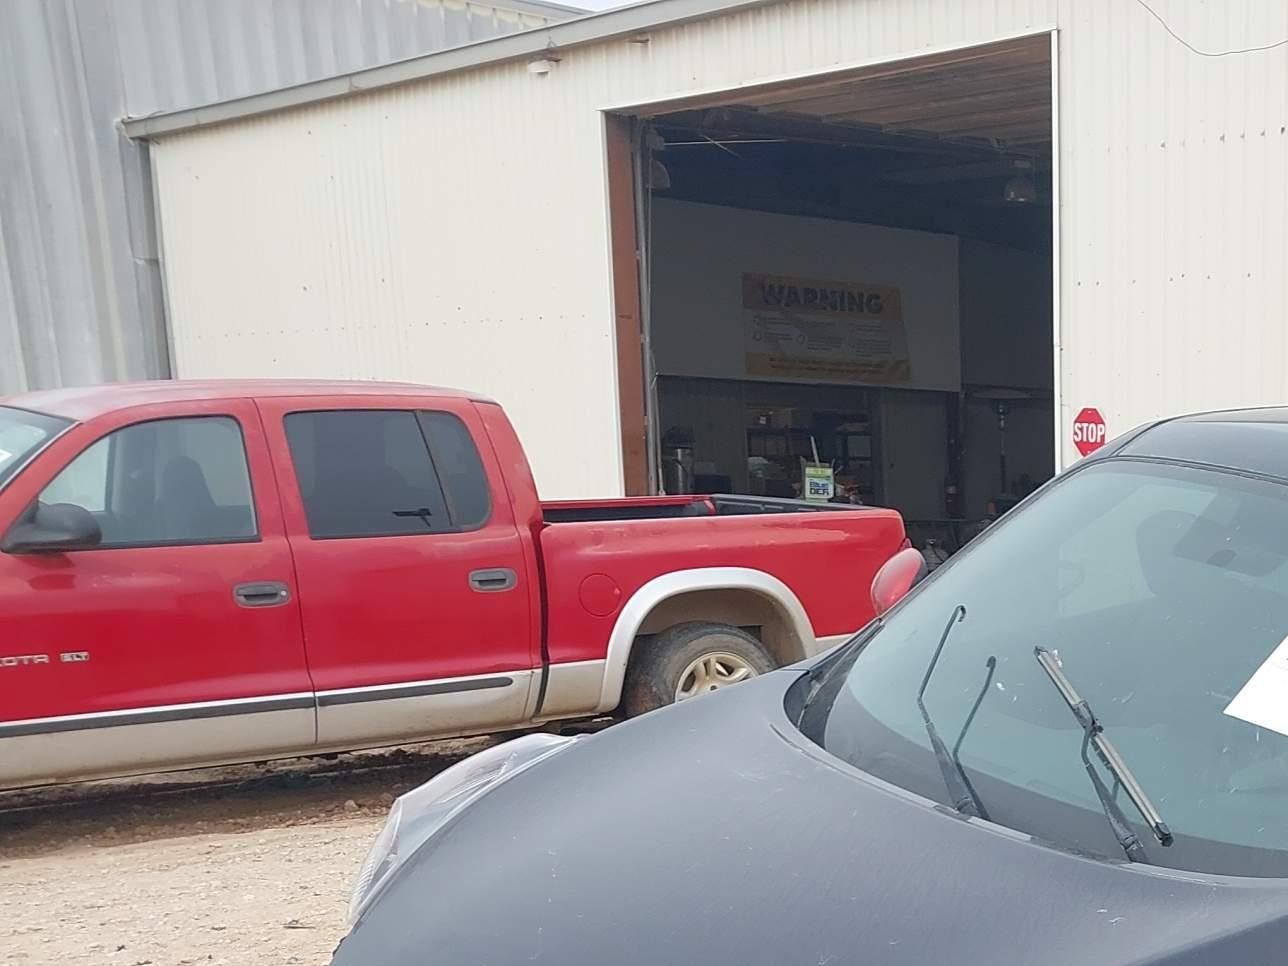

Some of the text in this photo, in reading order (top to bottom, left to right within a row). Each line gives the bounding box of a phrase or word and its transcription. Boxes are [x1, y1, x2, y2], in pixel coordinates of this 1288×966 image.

[762, 284, 883, 314] WARNING
[1074, 422, 1105, 443] STOP
[0, 654, 49, 667] OTA
